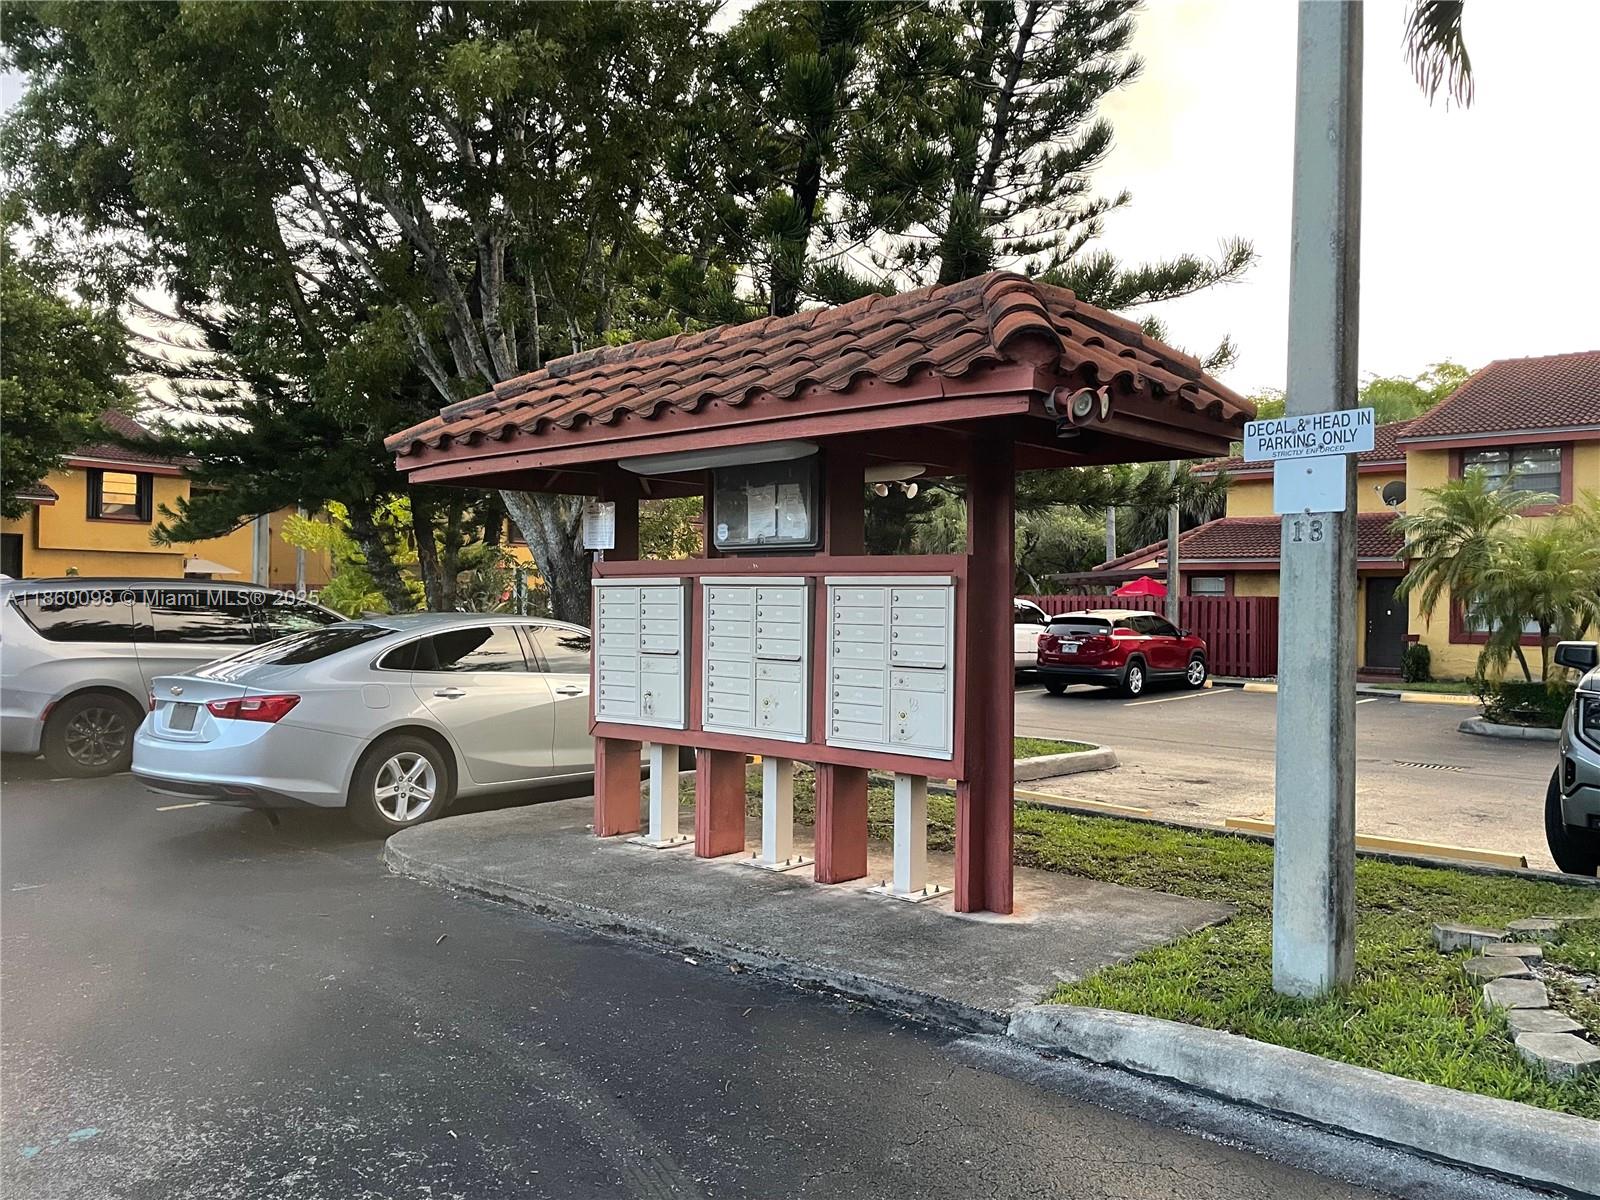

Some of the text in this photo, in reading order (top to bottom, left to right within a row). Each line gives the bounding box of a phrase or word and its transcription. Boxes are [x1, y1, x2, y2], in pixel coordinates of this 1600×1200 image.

[1248, 411, 1371, 438] DECAL & HEAD IN
[1258, 429, 1358, 451] PARKING ONLY
[1272, 445, 1345, 458] STRICTLY ENFORCED
